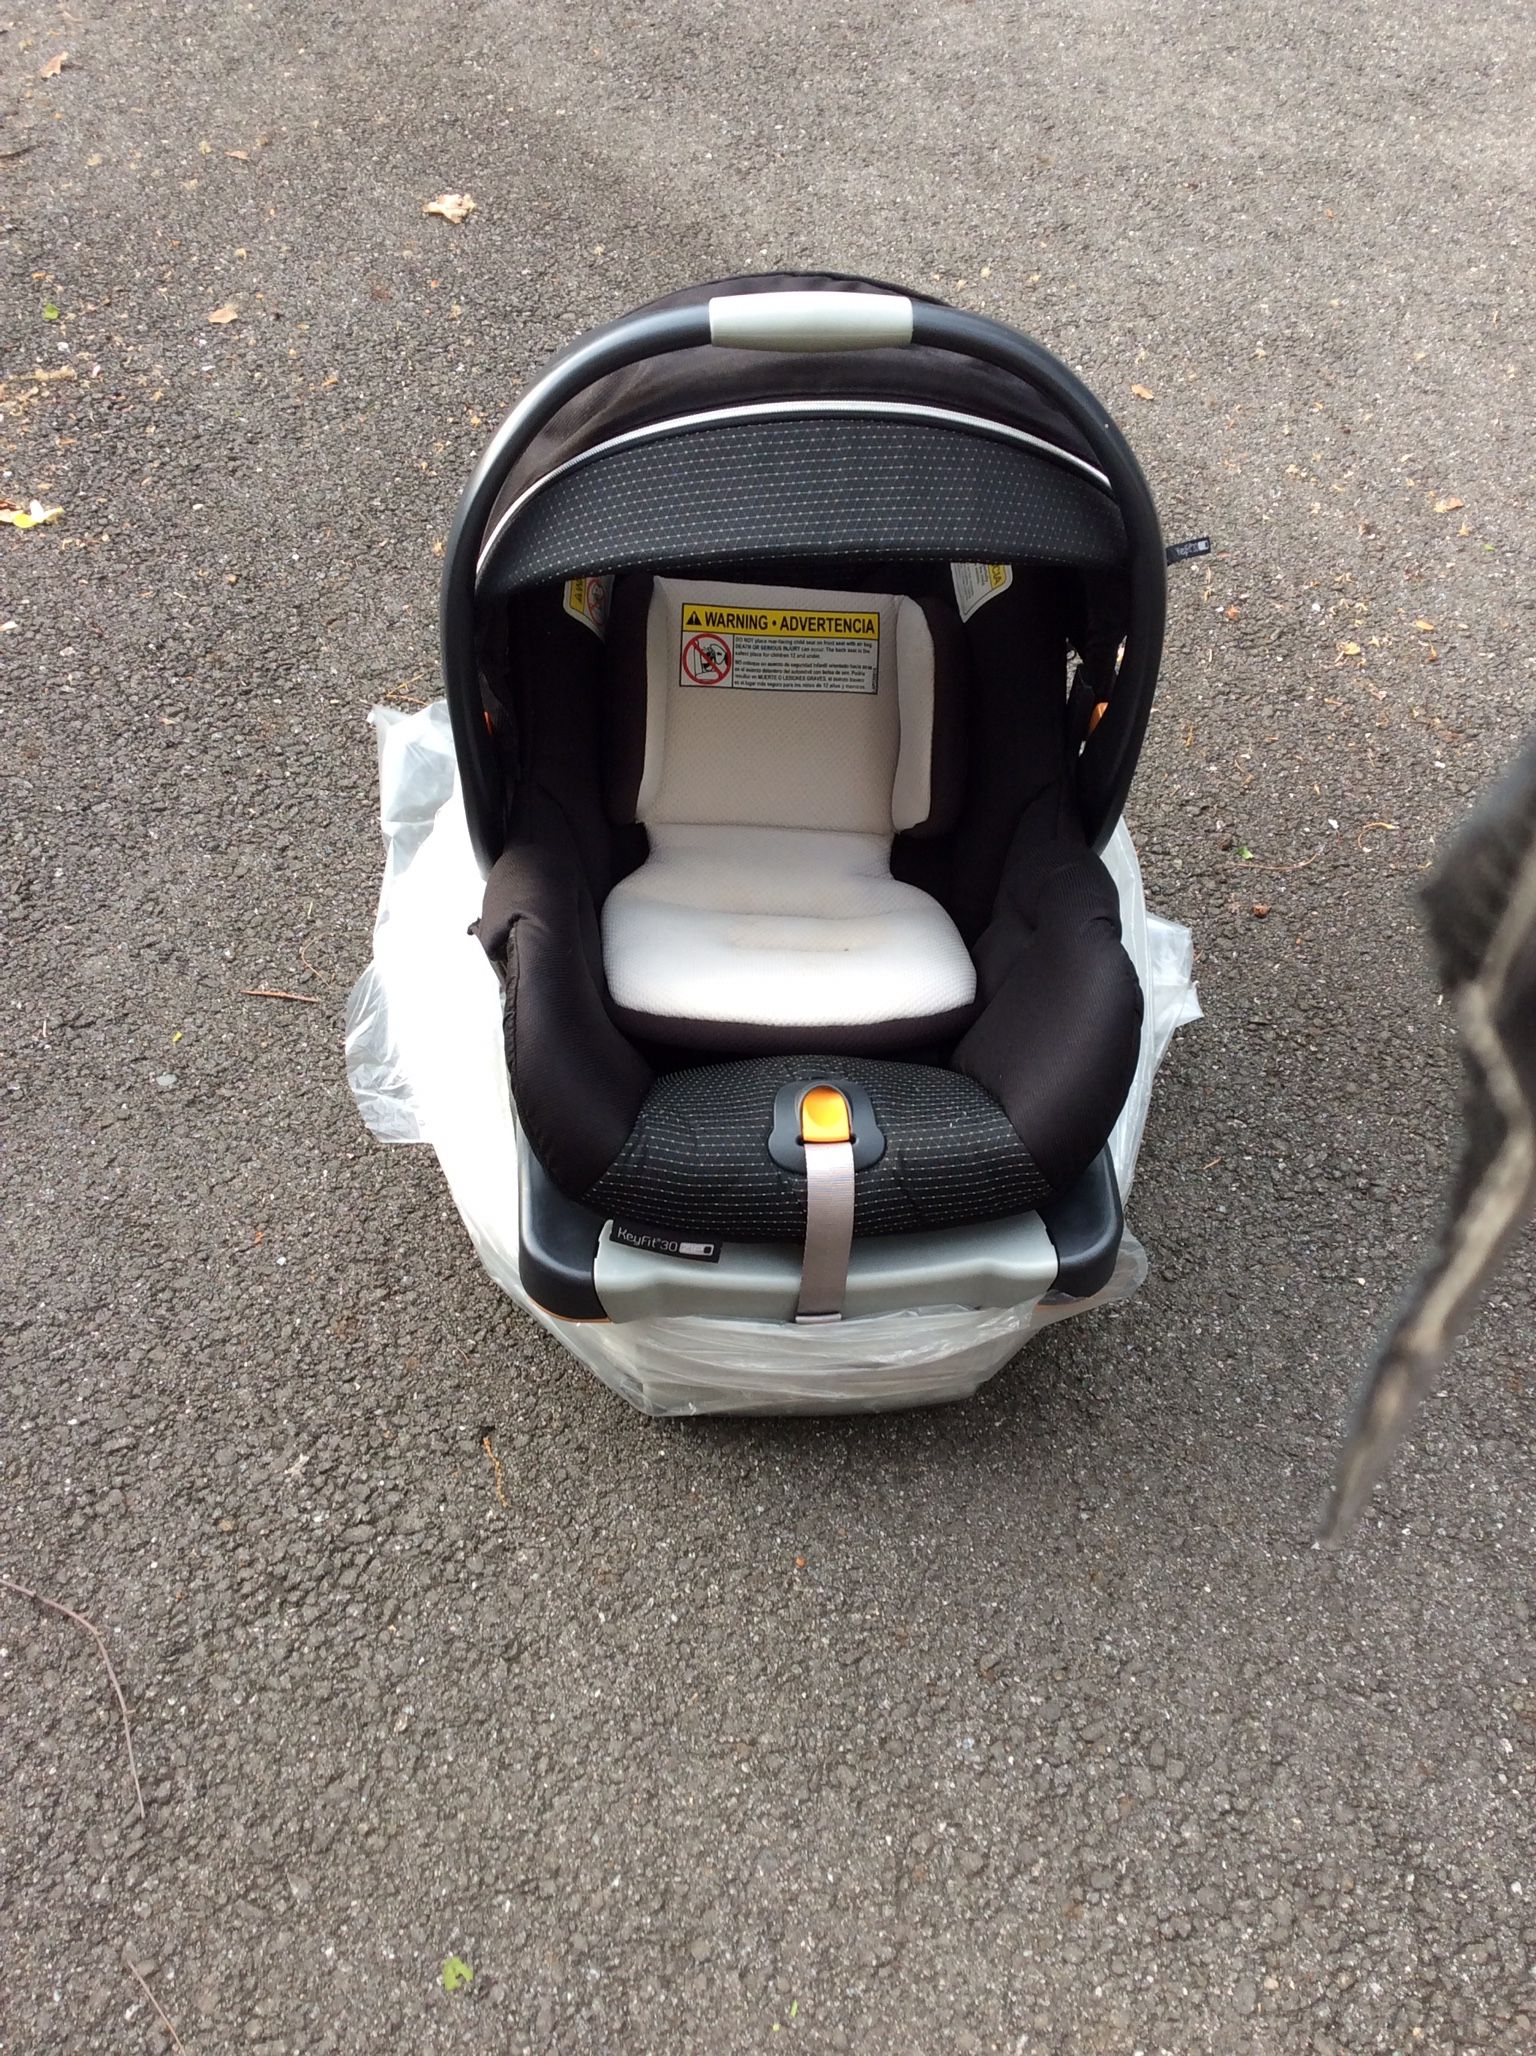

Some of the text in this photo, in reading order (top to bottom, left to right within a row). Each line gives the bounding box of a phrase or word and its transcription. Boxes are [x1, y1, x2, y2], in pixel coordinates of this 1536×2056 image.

[704, 611, 875, 634] WARNING ADVERTENCIA
[660, 1240, 678, 1252] 30
